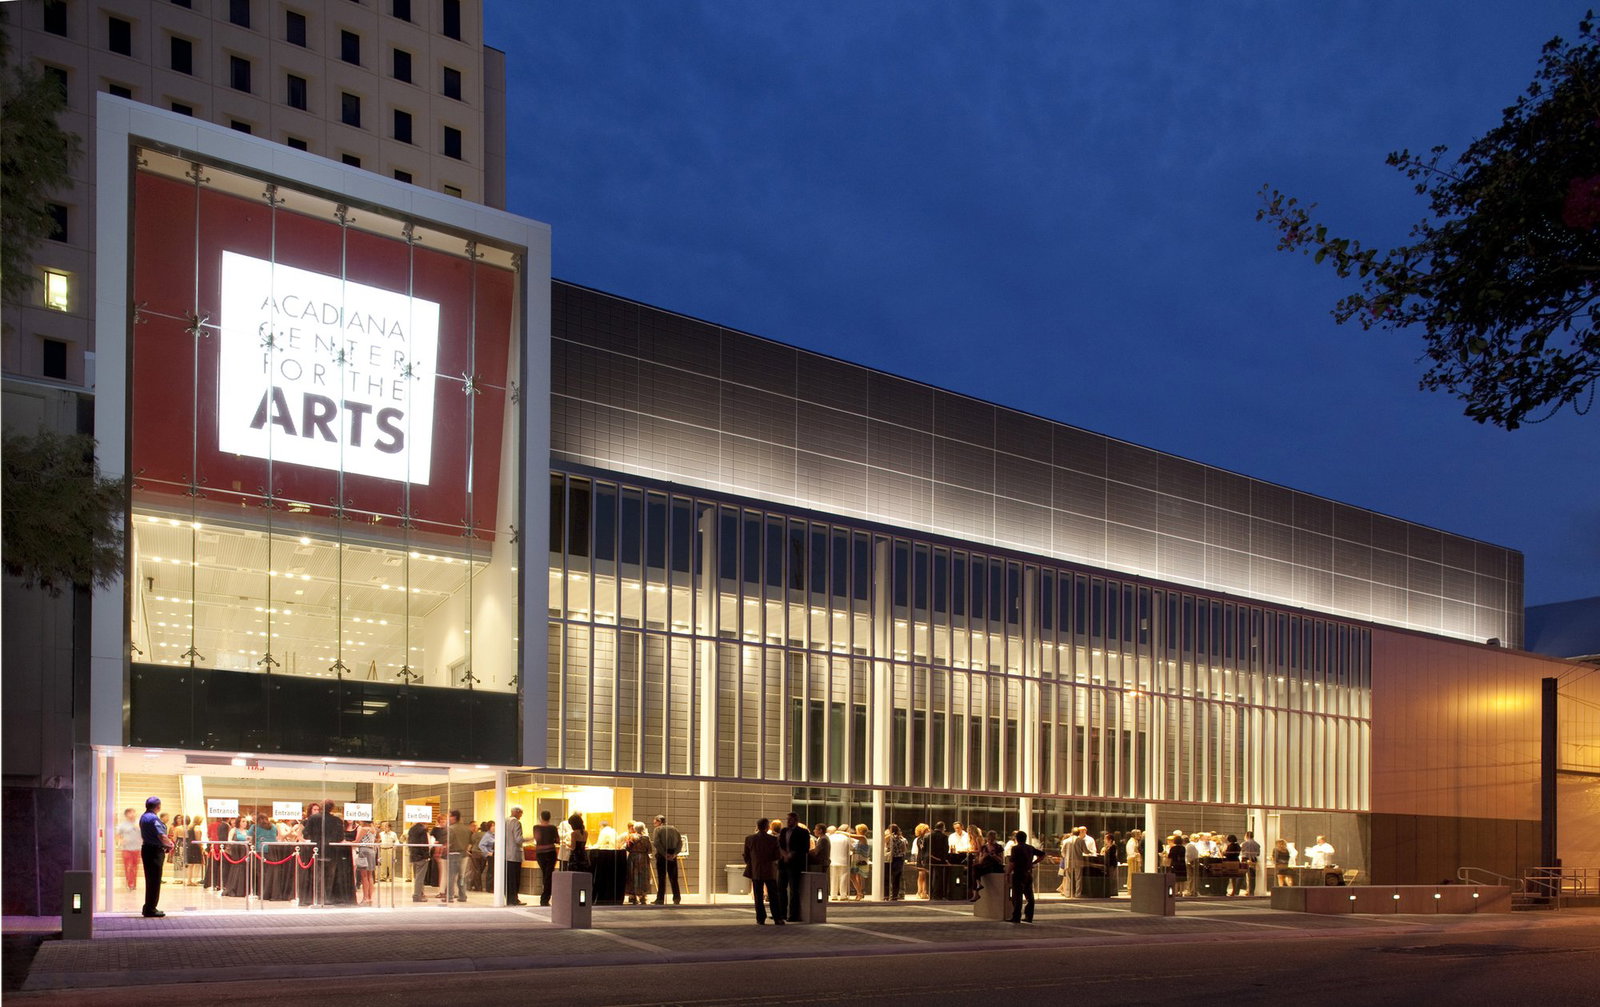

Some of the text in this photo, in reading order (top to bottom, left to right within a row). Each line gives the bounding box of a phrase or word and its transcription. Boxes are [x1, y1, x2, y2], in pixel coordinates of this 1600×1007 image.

[261, 295, 405, 342] ACADIANA
[259, 321, 406, 369] CENTER
[263, 352, 404, 401] FOR THE
[250, 385, 405, 454] ARTS
